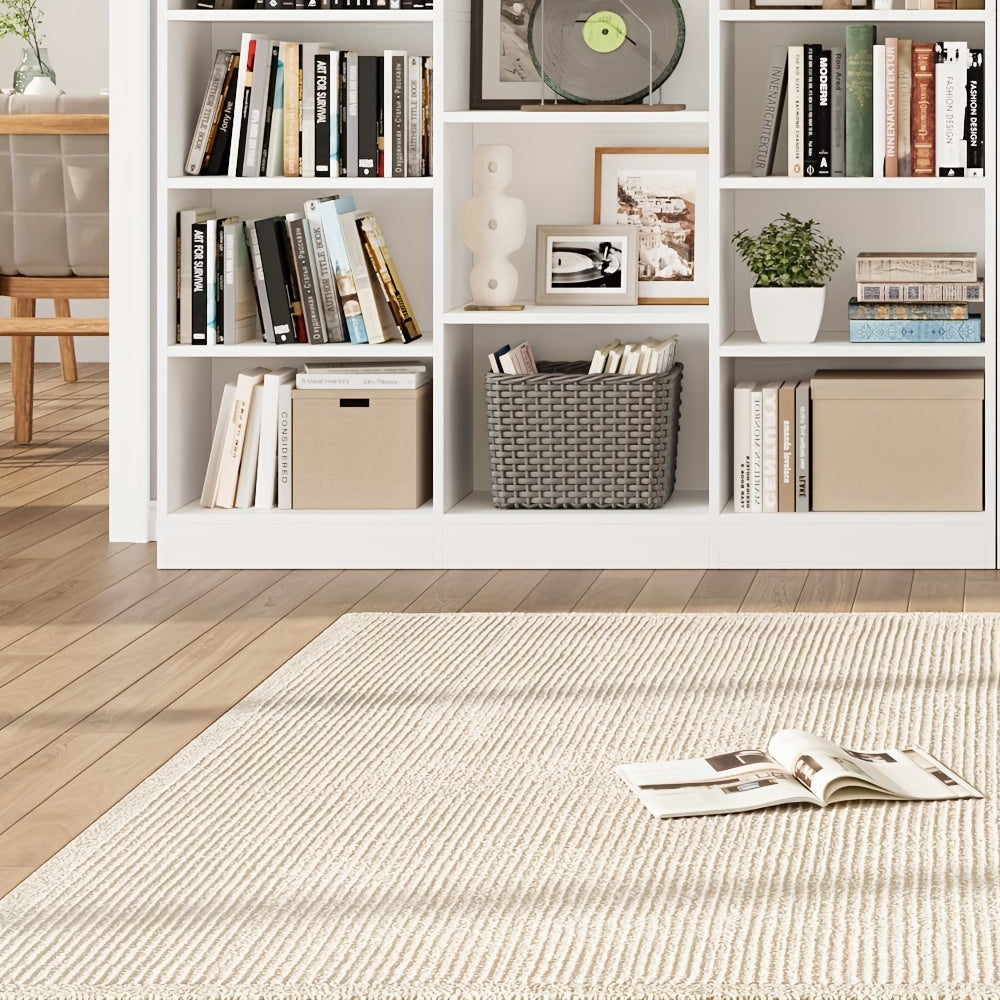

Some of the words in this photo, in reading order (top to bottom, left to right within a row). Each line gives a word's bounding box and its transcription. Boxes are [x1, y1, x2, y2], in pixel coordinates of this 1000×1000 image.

[316, 60, 327, 74] ART
[820, 57, 828, 106] MODERN
[316, 75, 327, 91] FOR
[946, 76, 954, 113] FASHION
[970, 80, 978, 115] FASHION
[219, 111, 230, 132] Jony
[226, 100, 234, 114] Ive
[755, 65, 783, 169] INNENARCHITEKTUR
[886, 46, 896, 157] INNENARCHITEKTUR
[946, 115, 954, 144] DESIGN
[970, 117, 978, 147] DESIGN
[194, 229, 204, 243] ART
[194, 244, 204, 260] FOR
